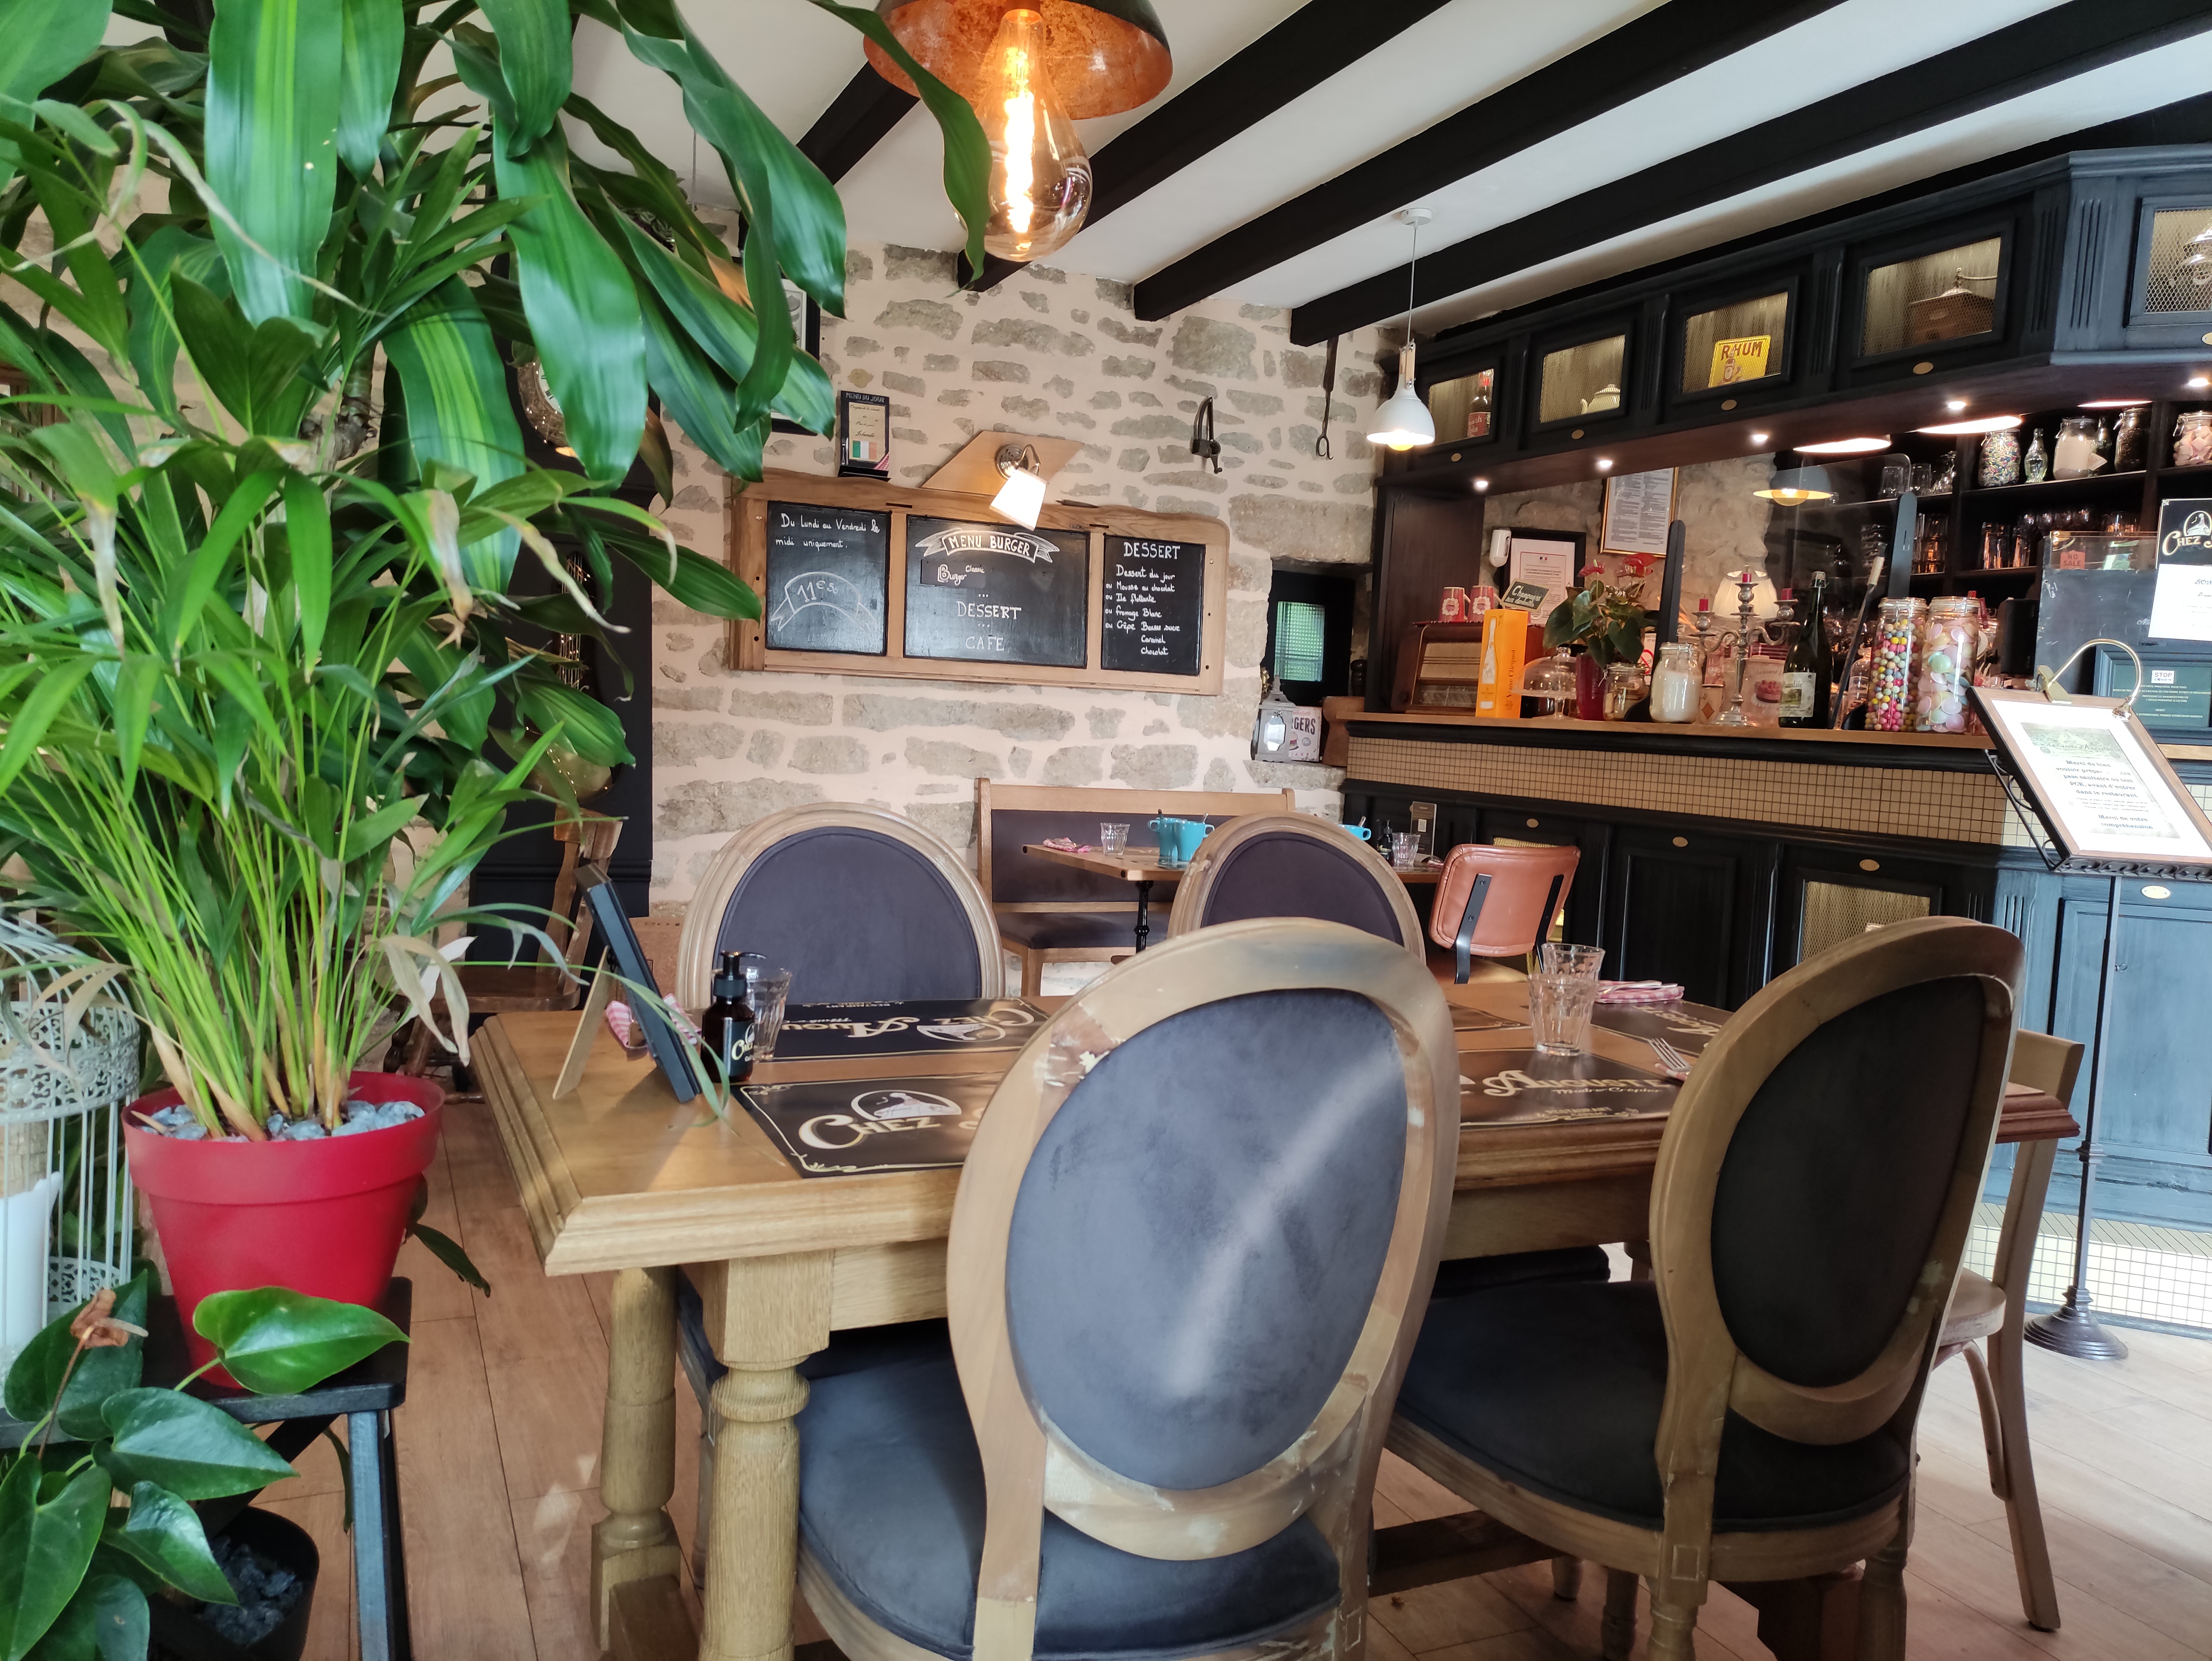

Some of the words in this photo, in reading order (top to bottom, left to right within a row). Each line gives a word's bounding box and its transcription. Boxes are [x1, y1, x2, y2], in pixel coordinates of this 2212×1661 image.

[1721, 342, 1763, 361] RHUM
[781, 513, 795, 527] Du
[836, 518, 867, 532] Vendredi
[871, 519, 880, 533] le
[775, 536, 795, 546] midi
[803, 539, 848, 551] uniquement.
[948, 535, 982, 549] MENU
[990, 535, 1030, 556] BURGER
[1124, 542, 1180, 559] DESSERT
[938, 564, 967, 586] Burger
[965, 565, 985, 574] Classic
[1116, 564, 1147, 577] Dessert
[1150, 568, 1159, 578] du
[1160, 572, 1175, 583] jour
[1117, 581, 1138, 590] Mousse
[1151, 583, 1175, 592] chocolat
[1512, 585, 1541, 602] Champagne
[957, 600, 1022, 620] DESSERT
[1142, 608, 1162, 618] Blanc
[1117, 620, 1136, 633] Crêpe
[1141, 621, 1161, 631] Beurre
[965, 636, 1004, 651] CAFE
[1141, 634, 1166, 643] Caramel
[1140, 646, 1169, 655] Chocolat
[1292, 717, 1316, 735] GERS
[781, 1017, 920, 1038] AUGU
[1482, 1070, 1672, 1096] AUGUSTE
[798, 1114, 942, 1149] CHEZ
